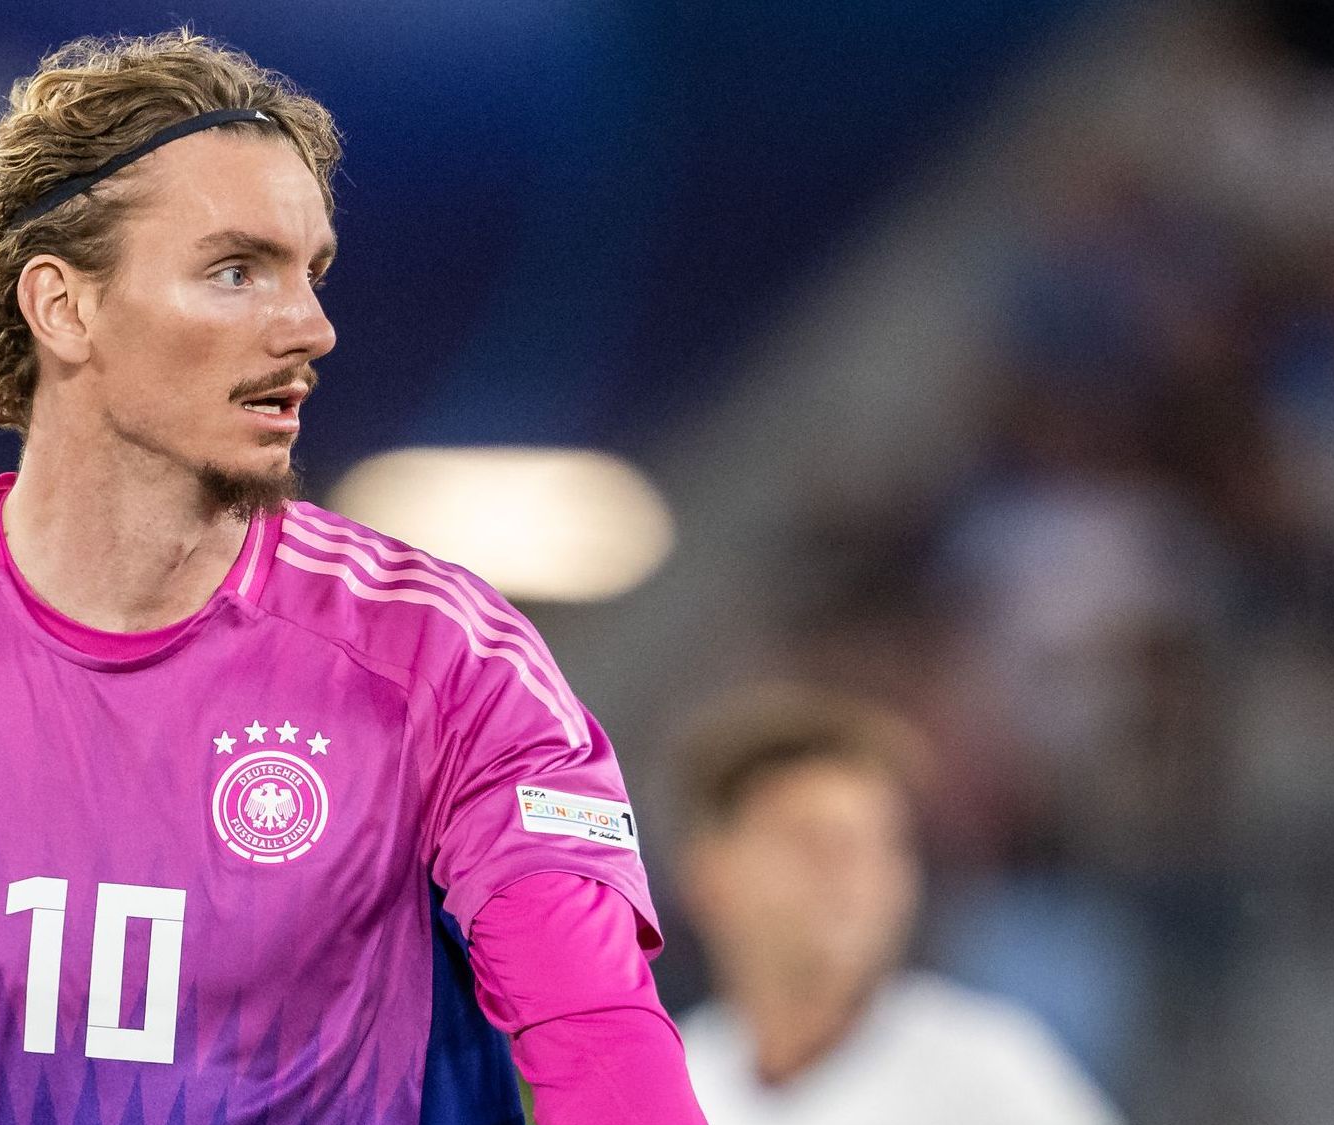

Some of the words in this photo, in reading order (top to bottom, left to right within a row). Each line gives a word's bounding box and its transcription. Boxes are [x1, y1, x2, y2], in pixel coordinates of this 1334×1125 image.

[238, 765, 304, 787] DEUTSCHER
[522, 789, 546, 798] UEFA
[524, 802, 620, 828] FOUNDATION
[230, 818, 309, 849] FUSSBALL-BUND
[5, 875, 187, 1065] 10
